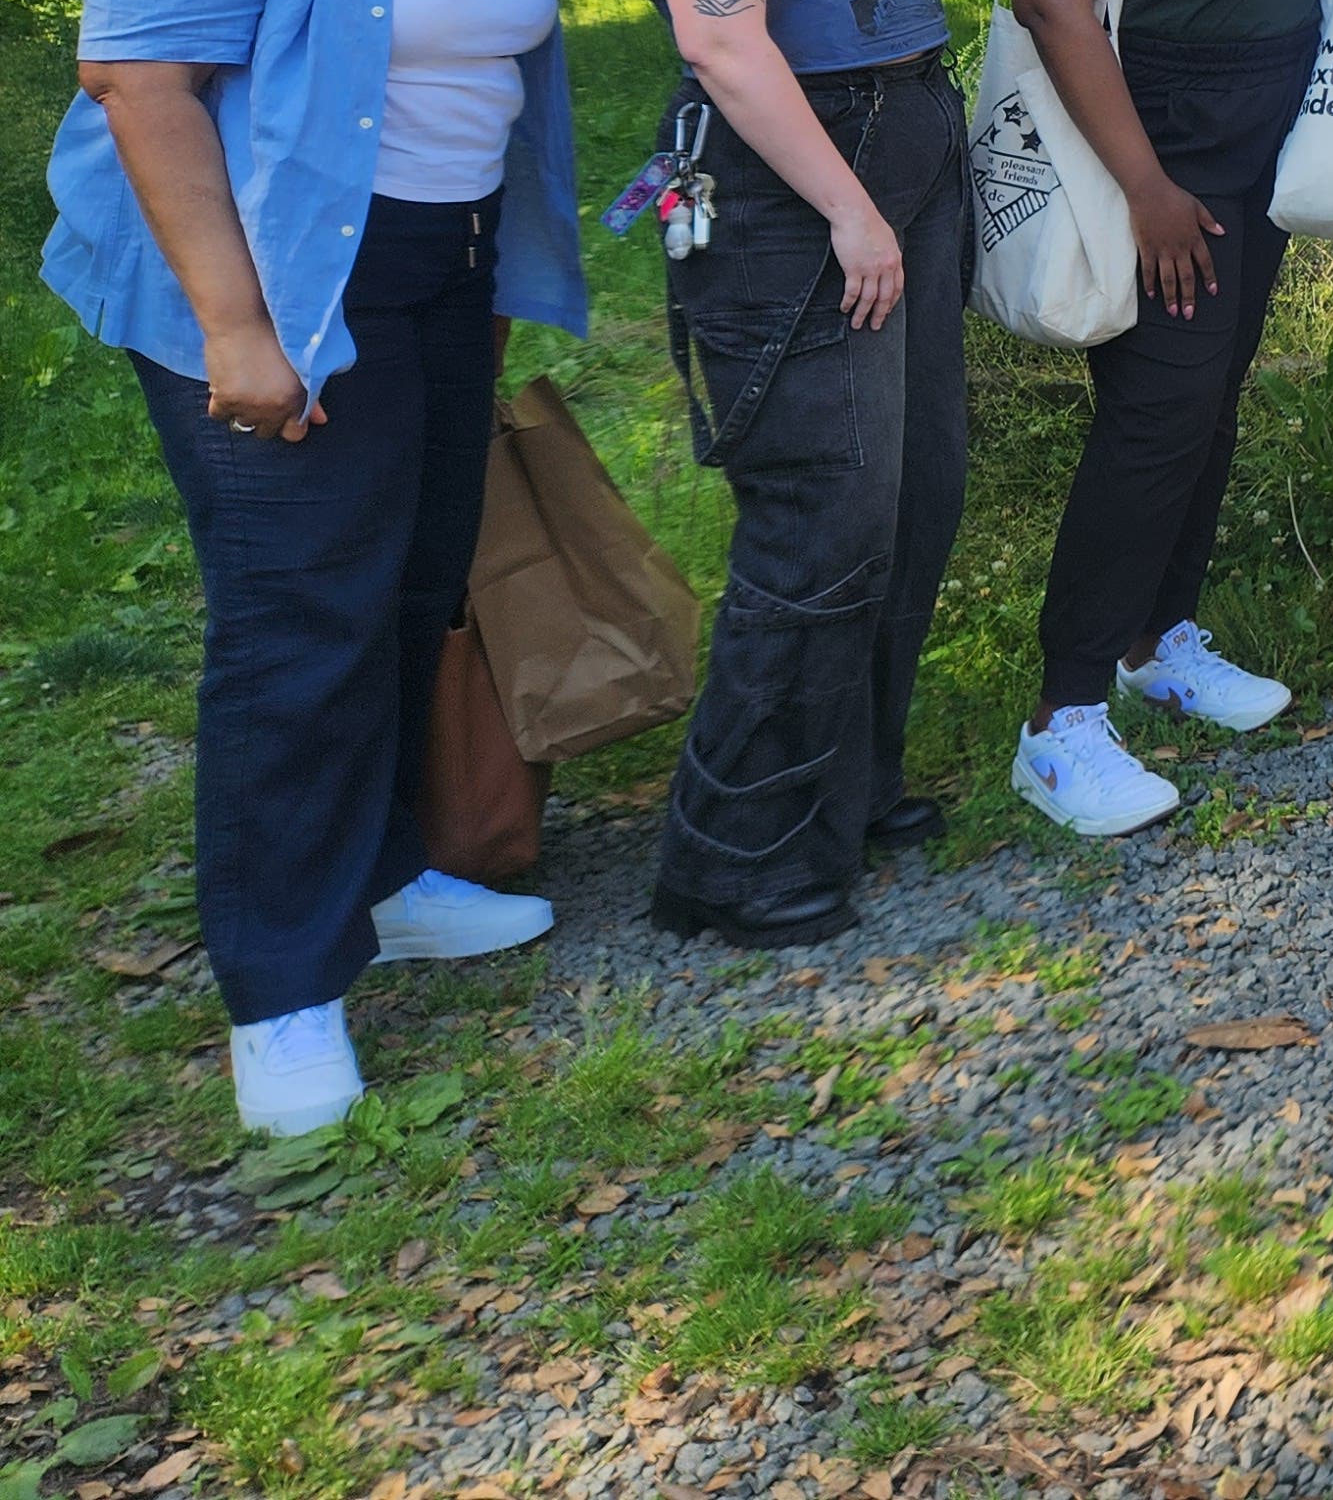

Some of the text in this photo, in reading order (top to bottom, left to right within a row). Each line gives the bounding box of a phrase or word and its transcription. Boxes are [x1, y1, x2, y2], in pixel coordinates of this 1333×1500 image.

[1001, 160, 1046, 176] pleasant
[1003, 170, 1038, 186] friends
[988, 189, 1006, 202] dc
